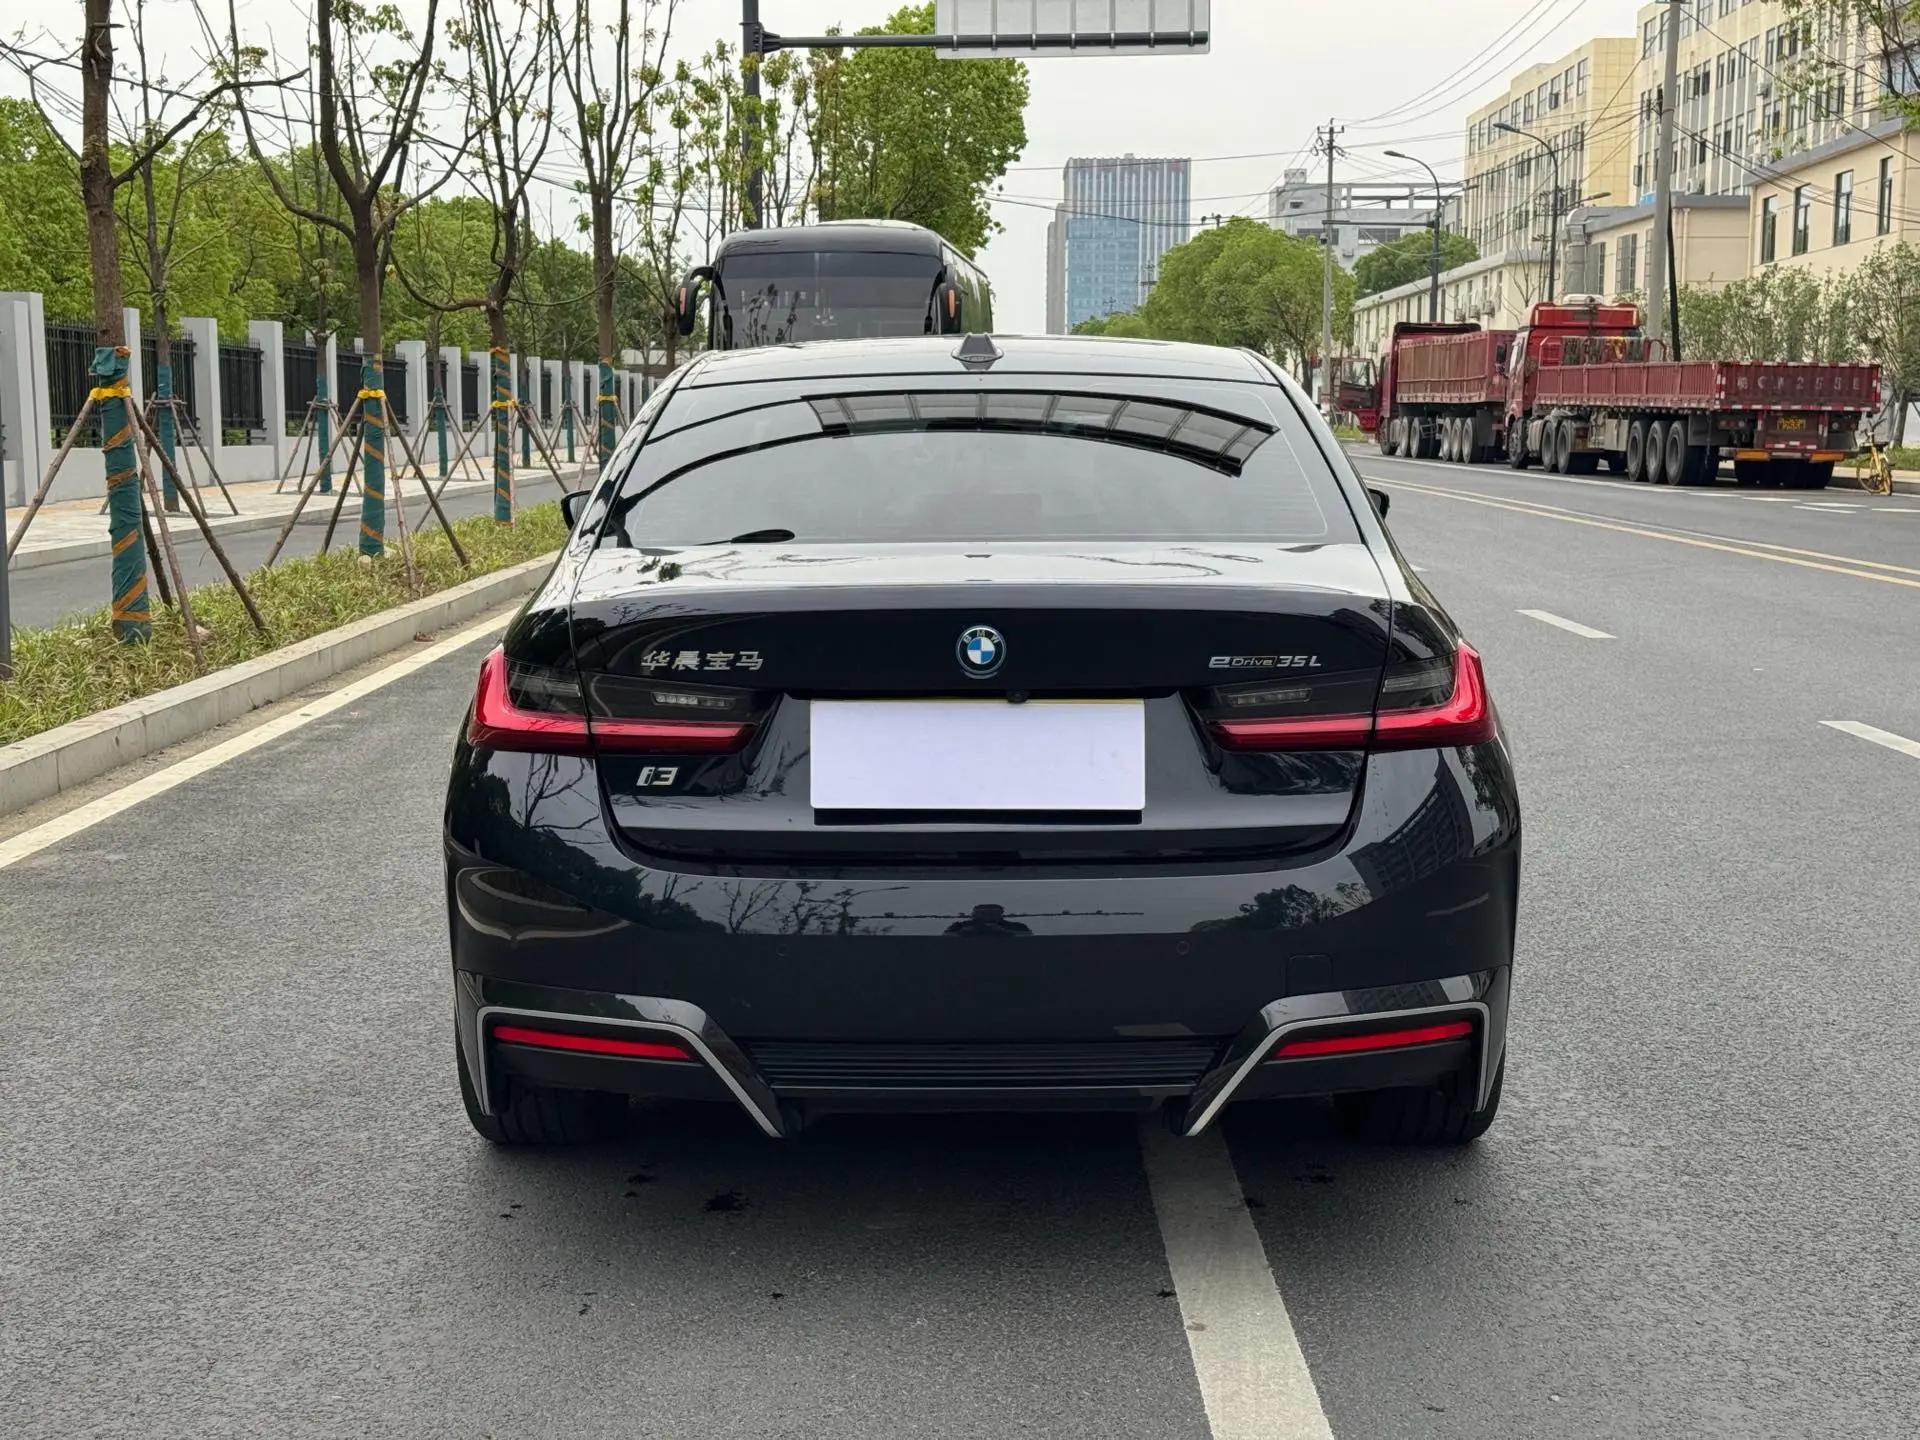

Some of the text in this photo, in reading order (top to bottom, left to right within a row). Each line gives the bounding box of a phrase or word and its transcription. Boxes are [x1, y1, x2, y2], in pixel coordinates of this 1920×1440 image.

[640, 650, 764, 670] 华晨宝马
[1208, 655, 1322, 668] eDrive 35L
[636, 766, 679, 787] i3
